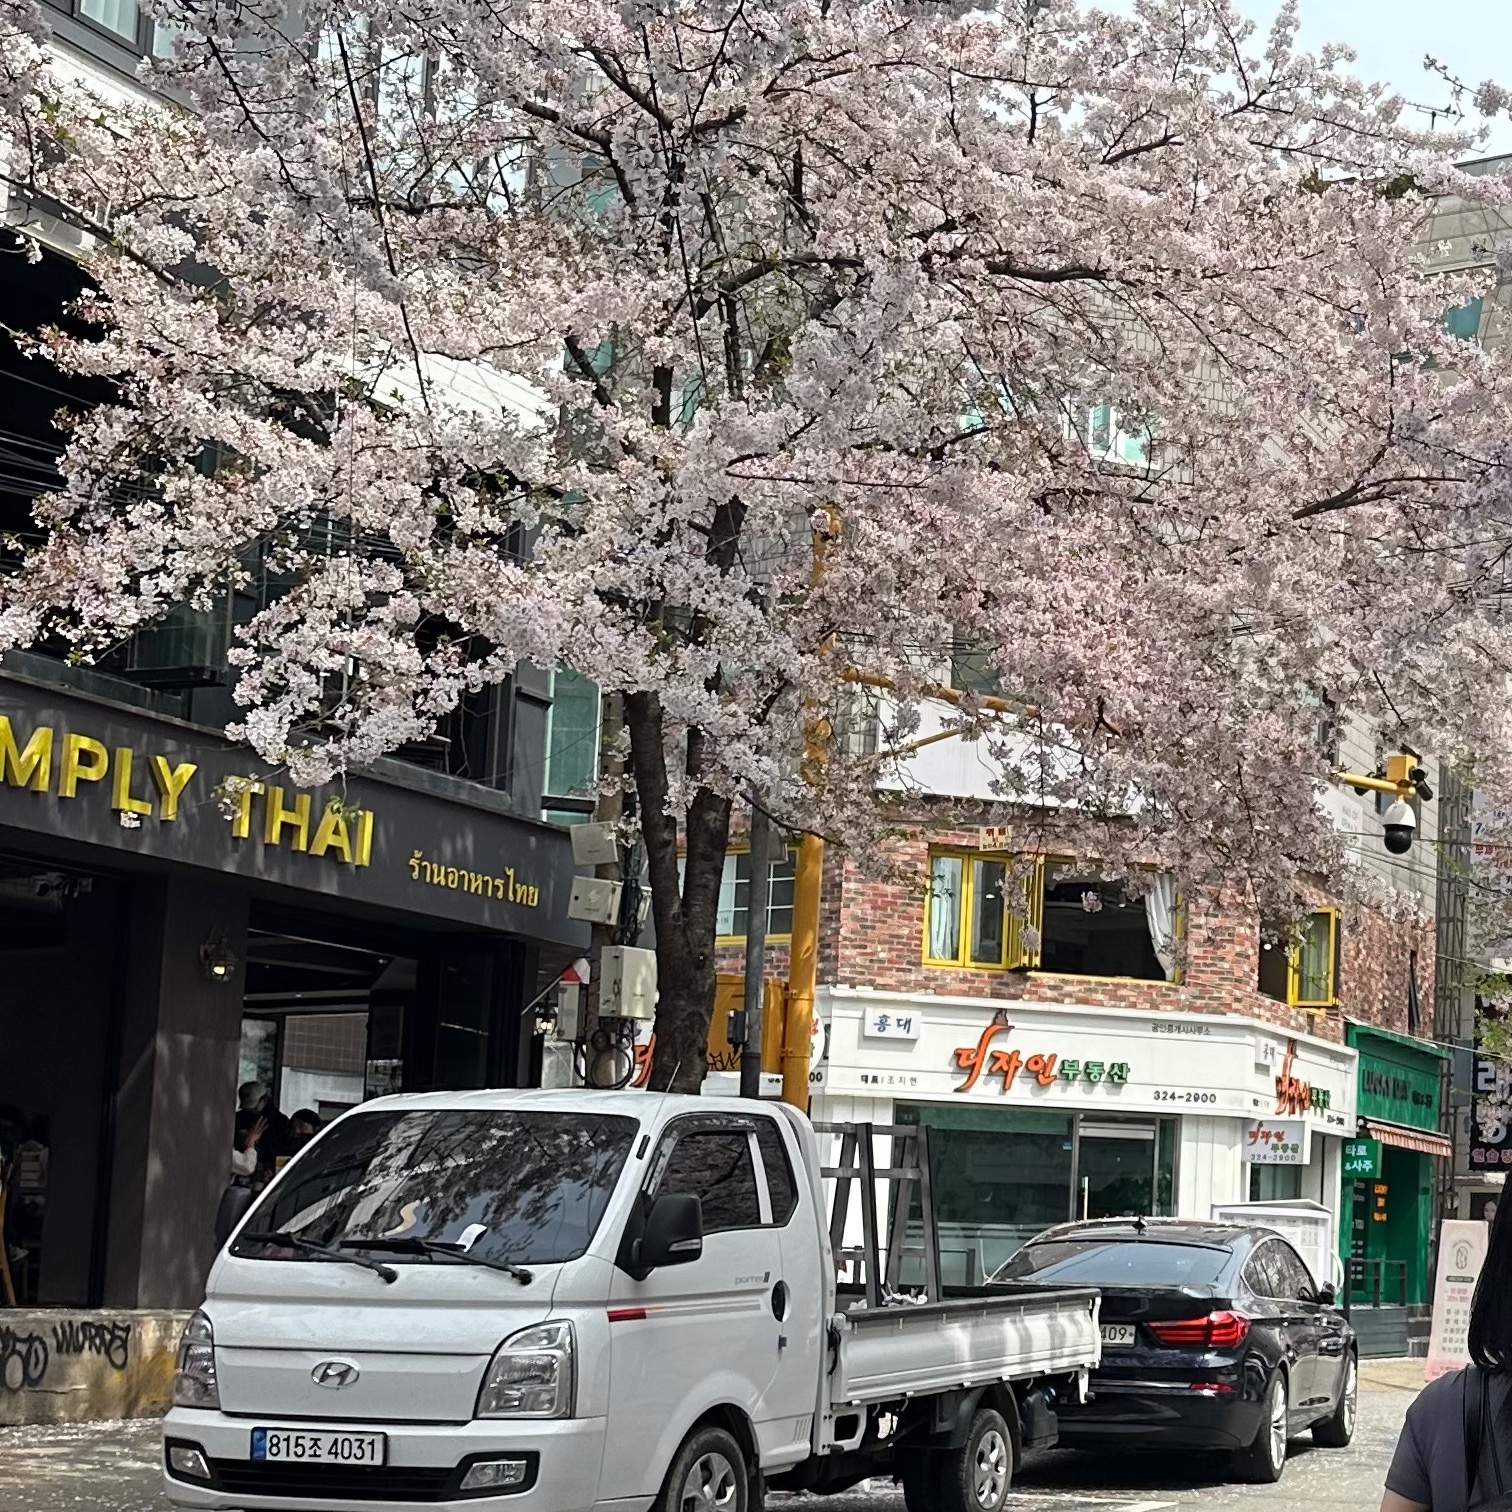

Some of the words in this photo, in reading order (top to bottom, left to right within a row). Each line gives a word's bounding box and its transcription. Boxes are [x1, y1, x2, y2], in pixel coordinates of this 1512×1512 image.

[226, 779, 375, 868] THAI
[408, 849, 540, 908] ร้านอาหารไทย
[873, 1013, 912, 1034] 홍대
[1060, 1059, 1132, 1085] 부동산
[1153, 1090, 1217, 1104] 324-2900
[1345, 1144, 1367, 1157] 타로
[267, 1433, 322, 1461] 815조
[326, 1435, 378, 1462] 4031
